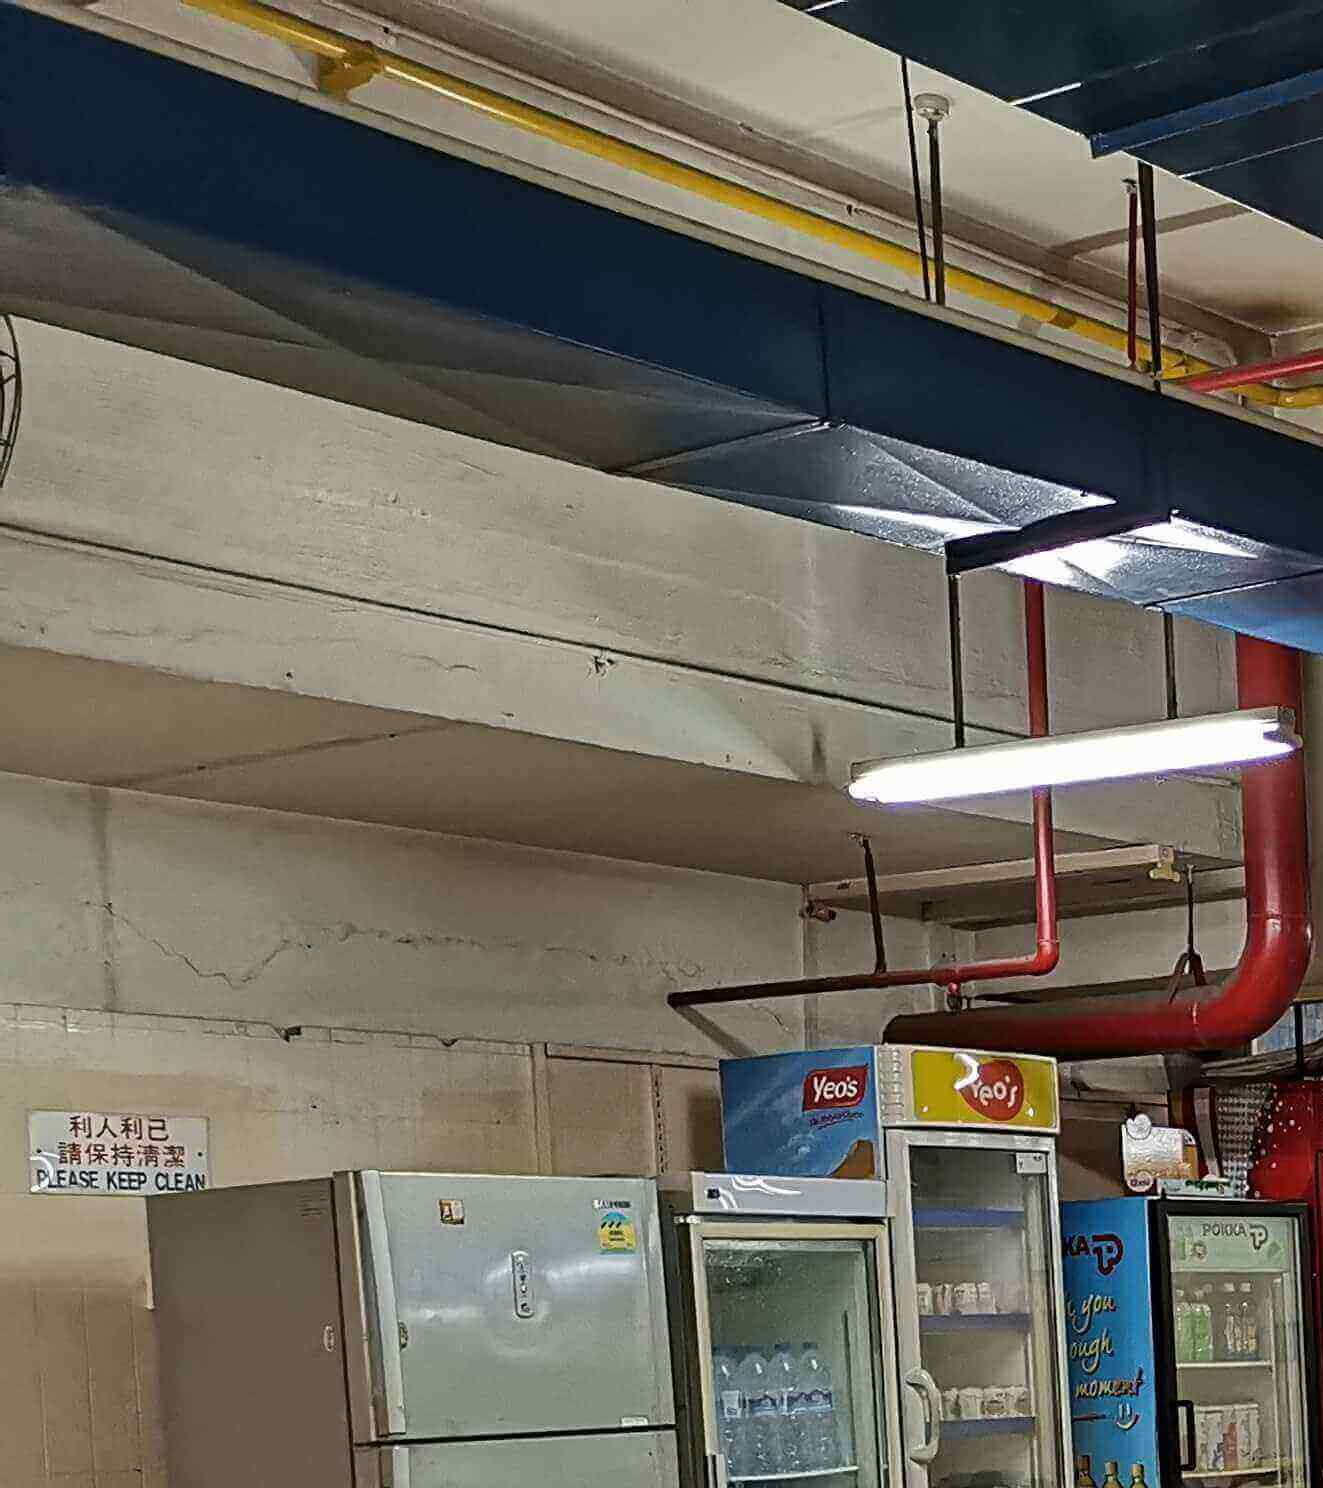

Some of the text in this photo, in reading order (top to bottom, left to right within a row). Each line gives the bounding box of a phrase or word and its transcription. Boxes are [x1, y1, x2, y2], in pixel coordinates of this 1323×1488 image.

[812, 1075, 859, 1104] Yeo's
[69, 1115, 169, 1141] 利人利己
[57, 1142, 185, 1167] 請保持清潔
[36, 1169, 206, 1191] PLEASE KEEP CLEAN
[1201, 1223, 1247, 1237] POKKA
